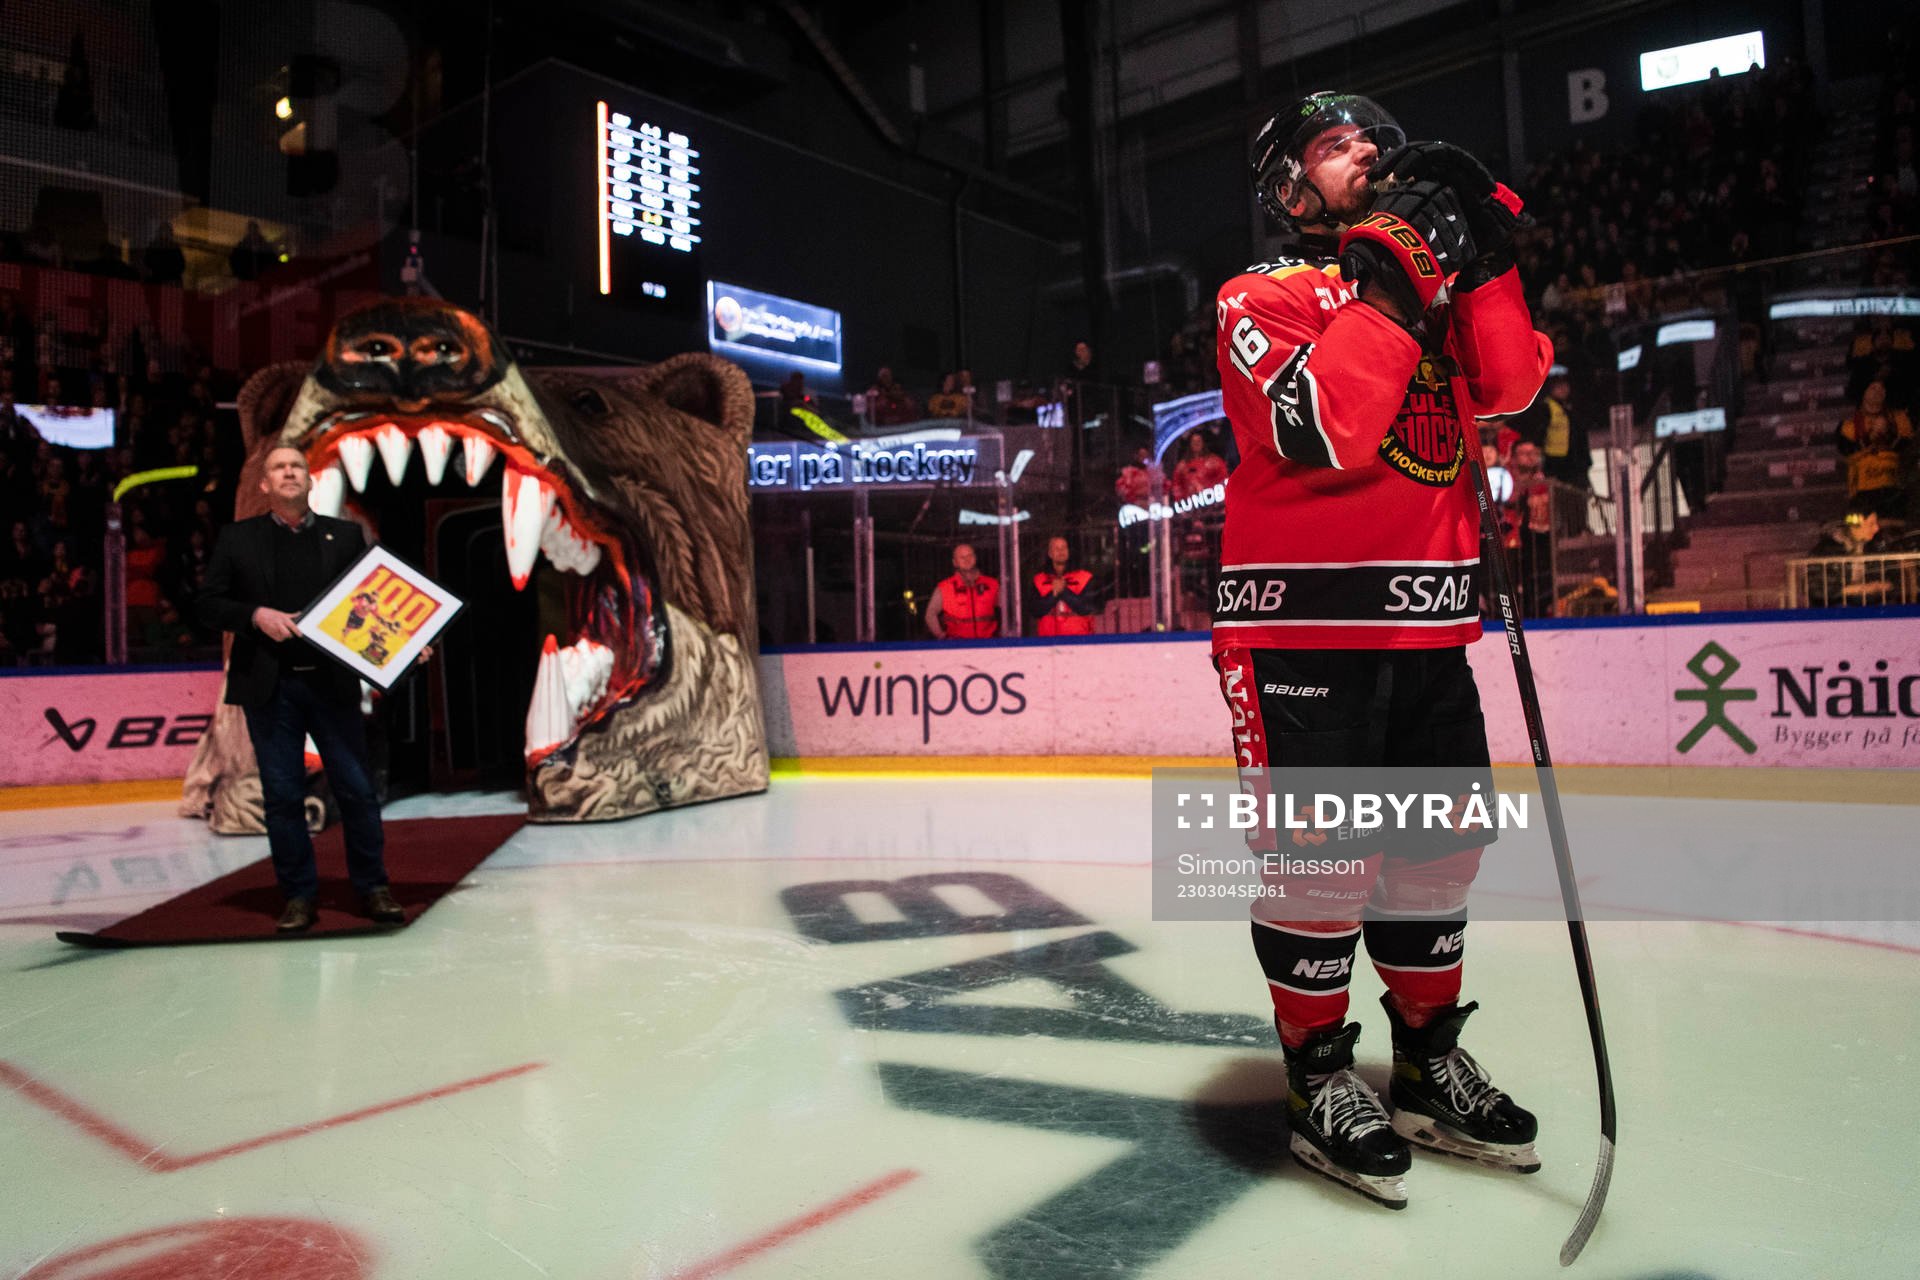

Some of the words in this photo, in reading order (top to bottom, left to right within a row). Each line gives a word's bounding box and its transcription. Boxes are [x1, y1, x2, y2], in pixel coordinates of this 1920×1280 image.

[1567, 68, 1609, 125] B
[799, 440, 844, 491] på
[850, 441, 978, 487] hockey
[363, 565, 437, 632] 100
[1216, 578, 1287, 613] SSAB
[1384, 573, 1471, 613] SSAB
[817, 660, 1027, 745] winpos
[1775, 723, 1853, 751] Bygger
[1862, 725, 1892, 750] på
[1430, 930, 1464, 955] NE
